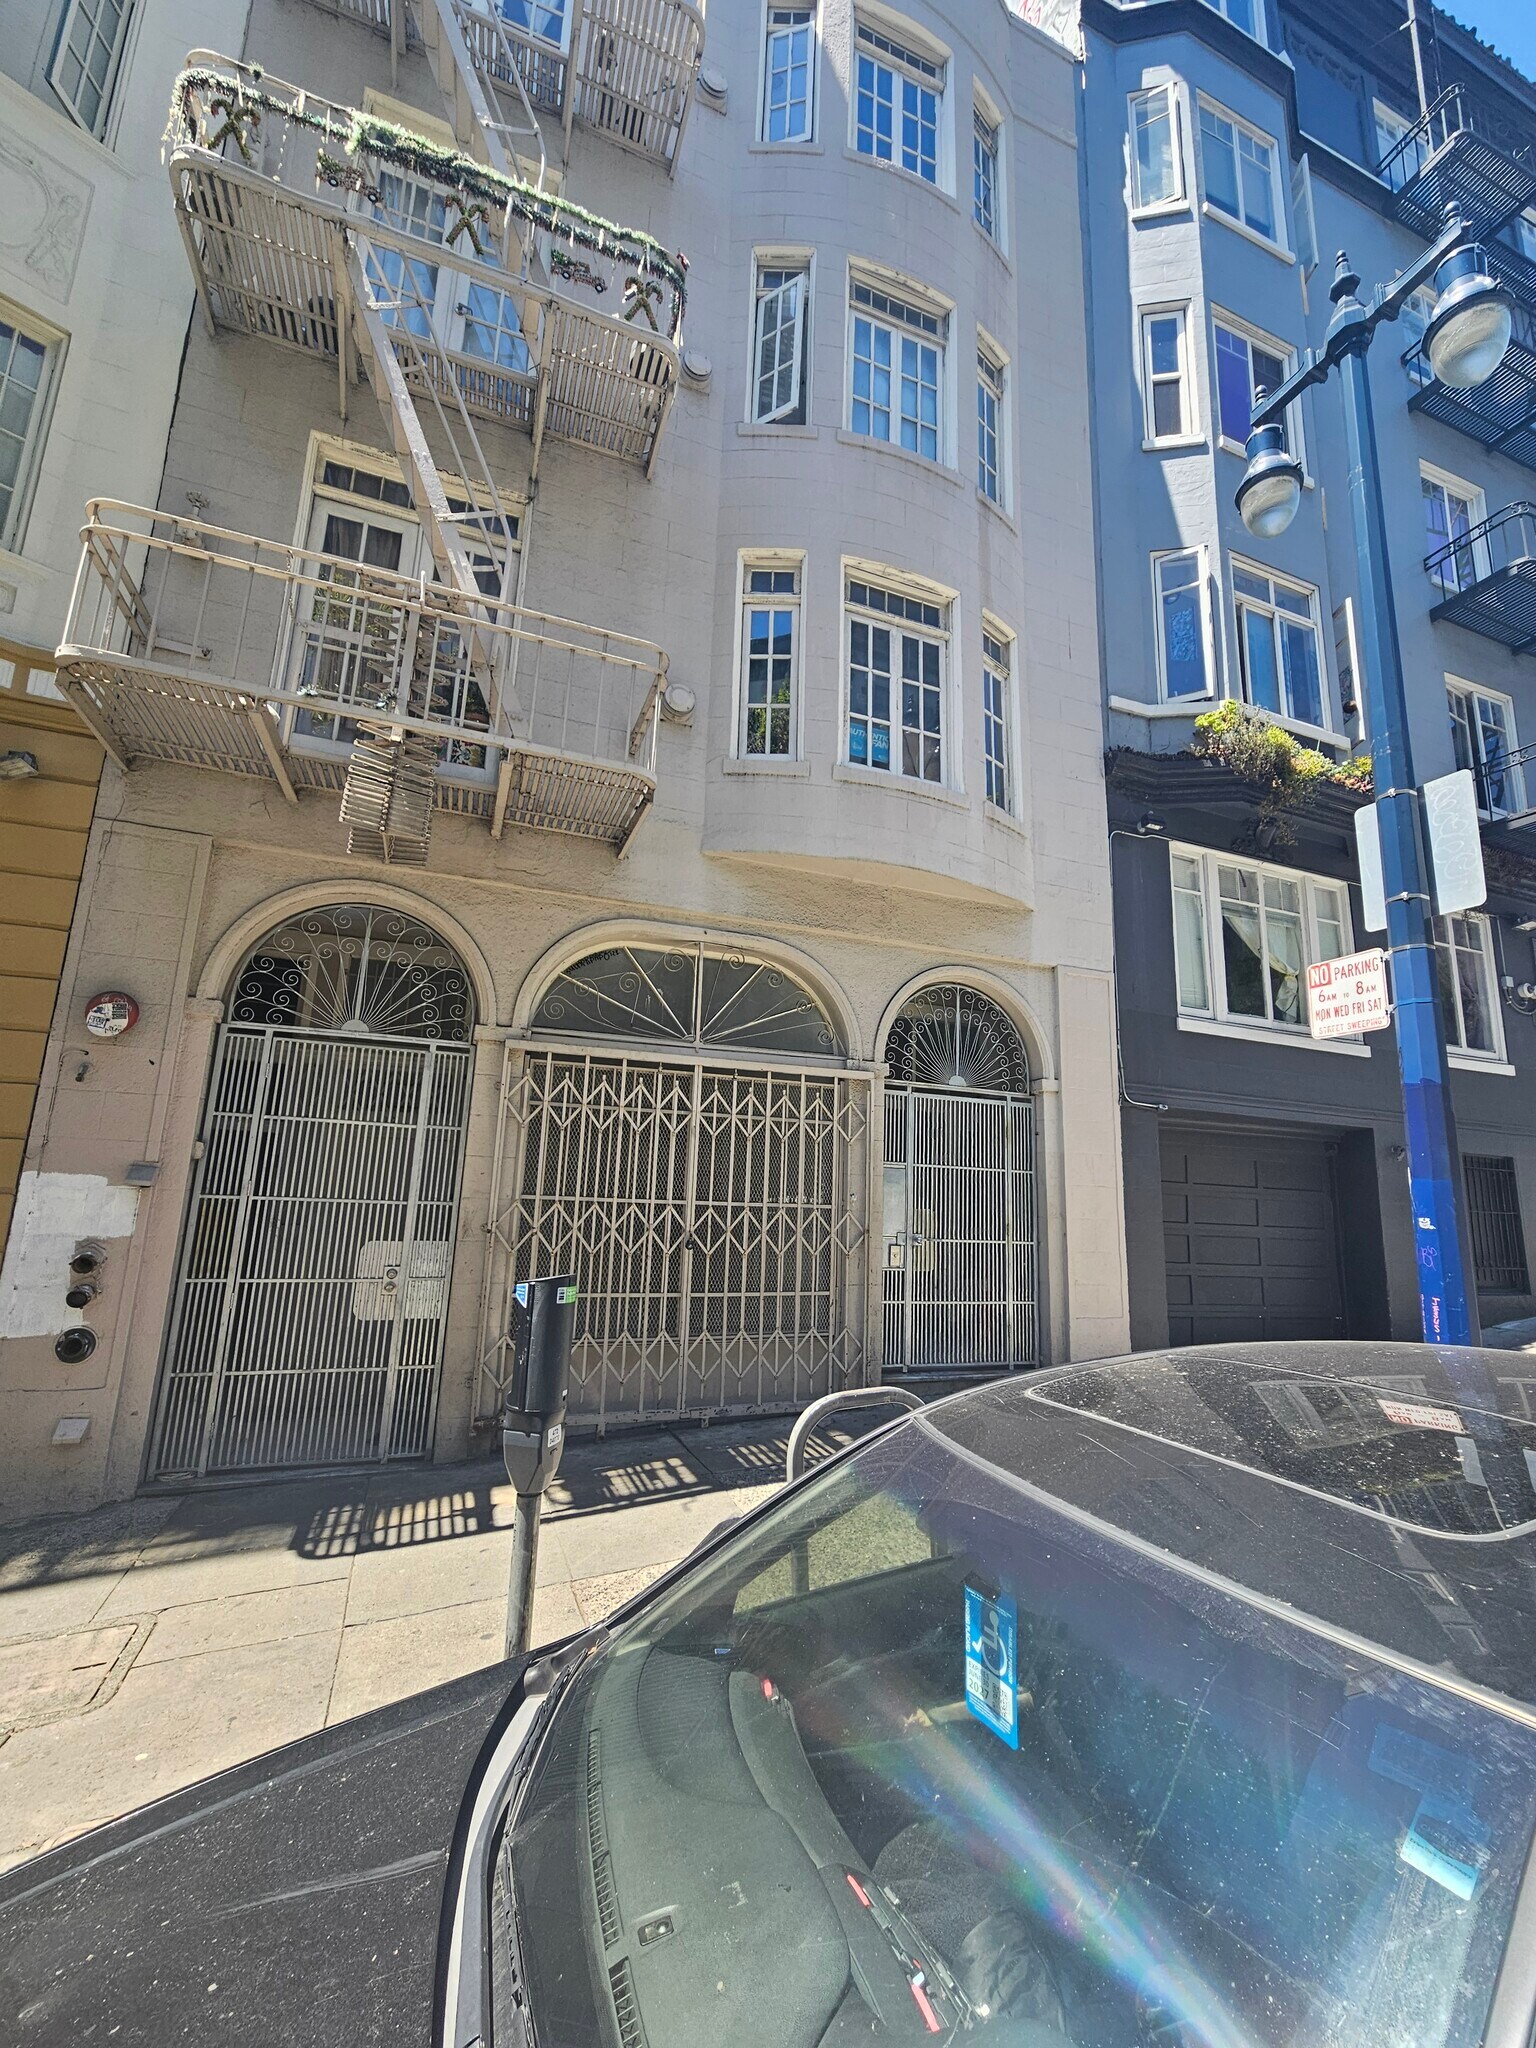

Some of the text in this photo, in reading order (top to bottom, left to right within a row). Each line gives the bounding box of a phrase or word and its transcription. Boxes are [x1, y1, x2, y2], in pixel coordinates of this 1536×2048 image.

[1310, 957, 1379, 987] NO PARKING
[1315, 997, 1382, 1022] MON WED FRI SAT
[1319, 1017, 1383, 1034] STREET SWEEPING
[968, 1677, 990, 1700] 2027
